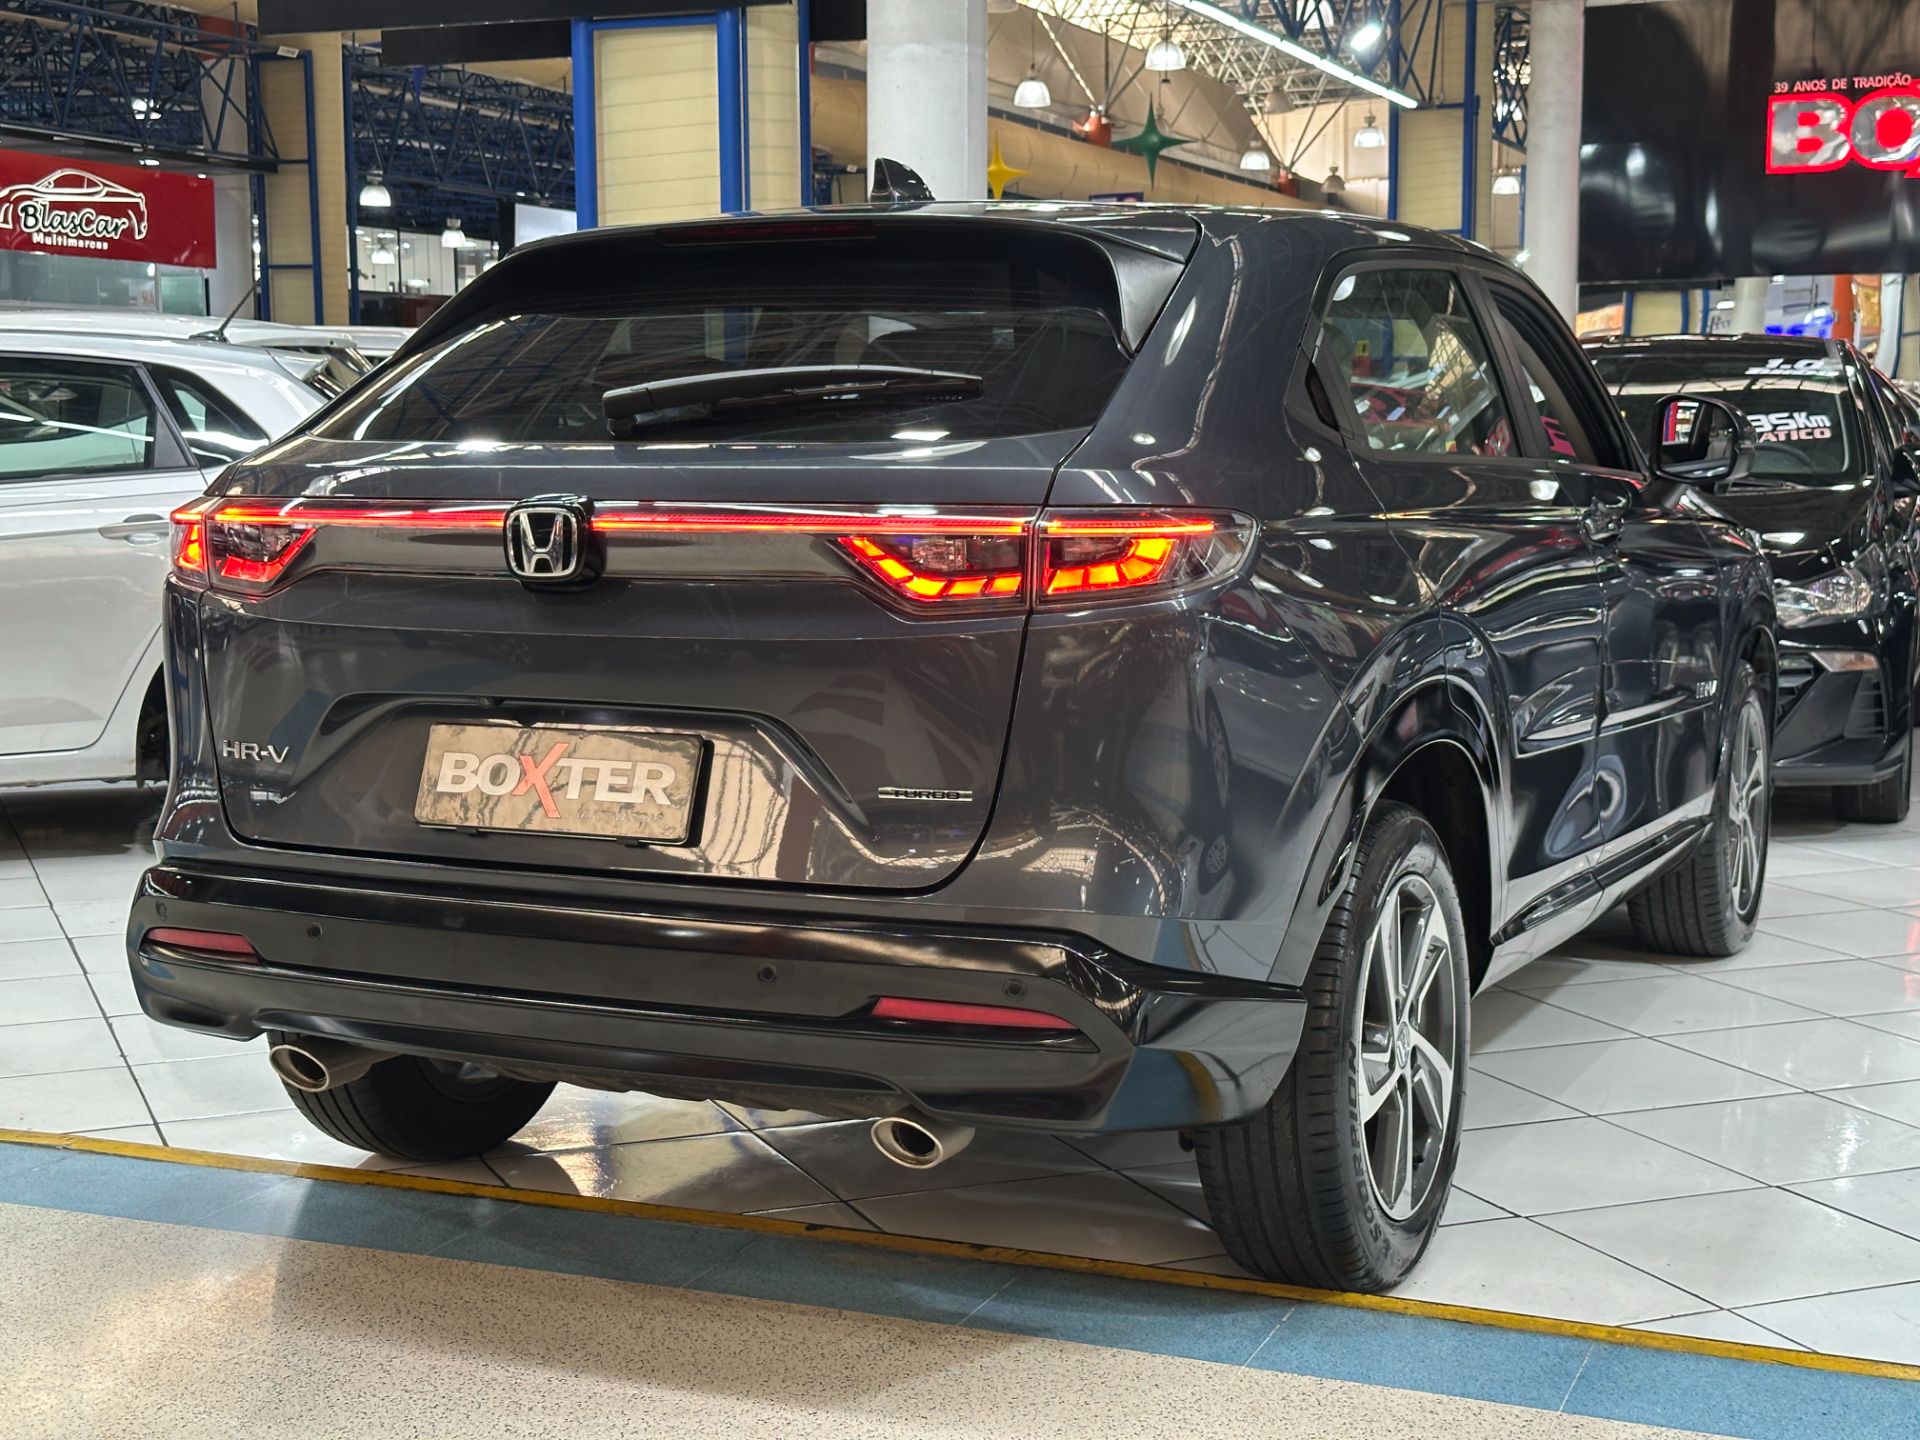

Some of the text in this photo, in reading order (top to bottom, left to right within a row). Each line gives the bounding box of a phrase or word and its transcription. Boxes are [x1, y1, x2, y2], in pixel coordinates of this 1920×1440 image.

[1774, 72, 1911, 93] 39 ANOS DE TRADIÇÃO
[1766, 84, 1920, 177] BO
[19, 200, 128, 239] BlasCar
[32, 232, 108, 250] Multimarcas
[1757, 428, 1833, 443] ATICO
[222, 739, 289, 764] HR-V
[436, 742, 676, 818] BOXTER
[892, 789, 960, 800] TURBO
